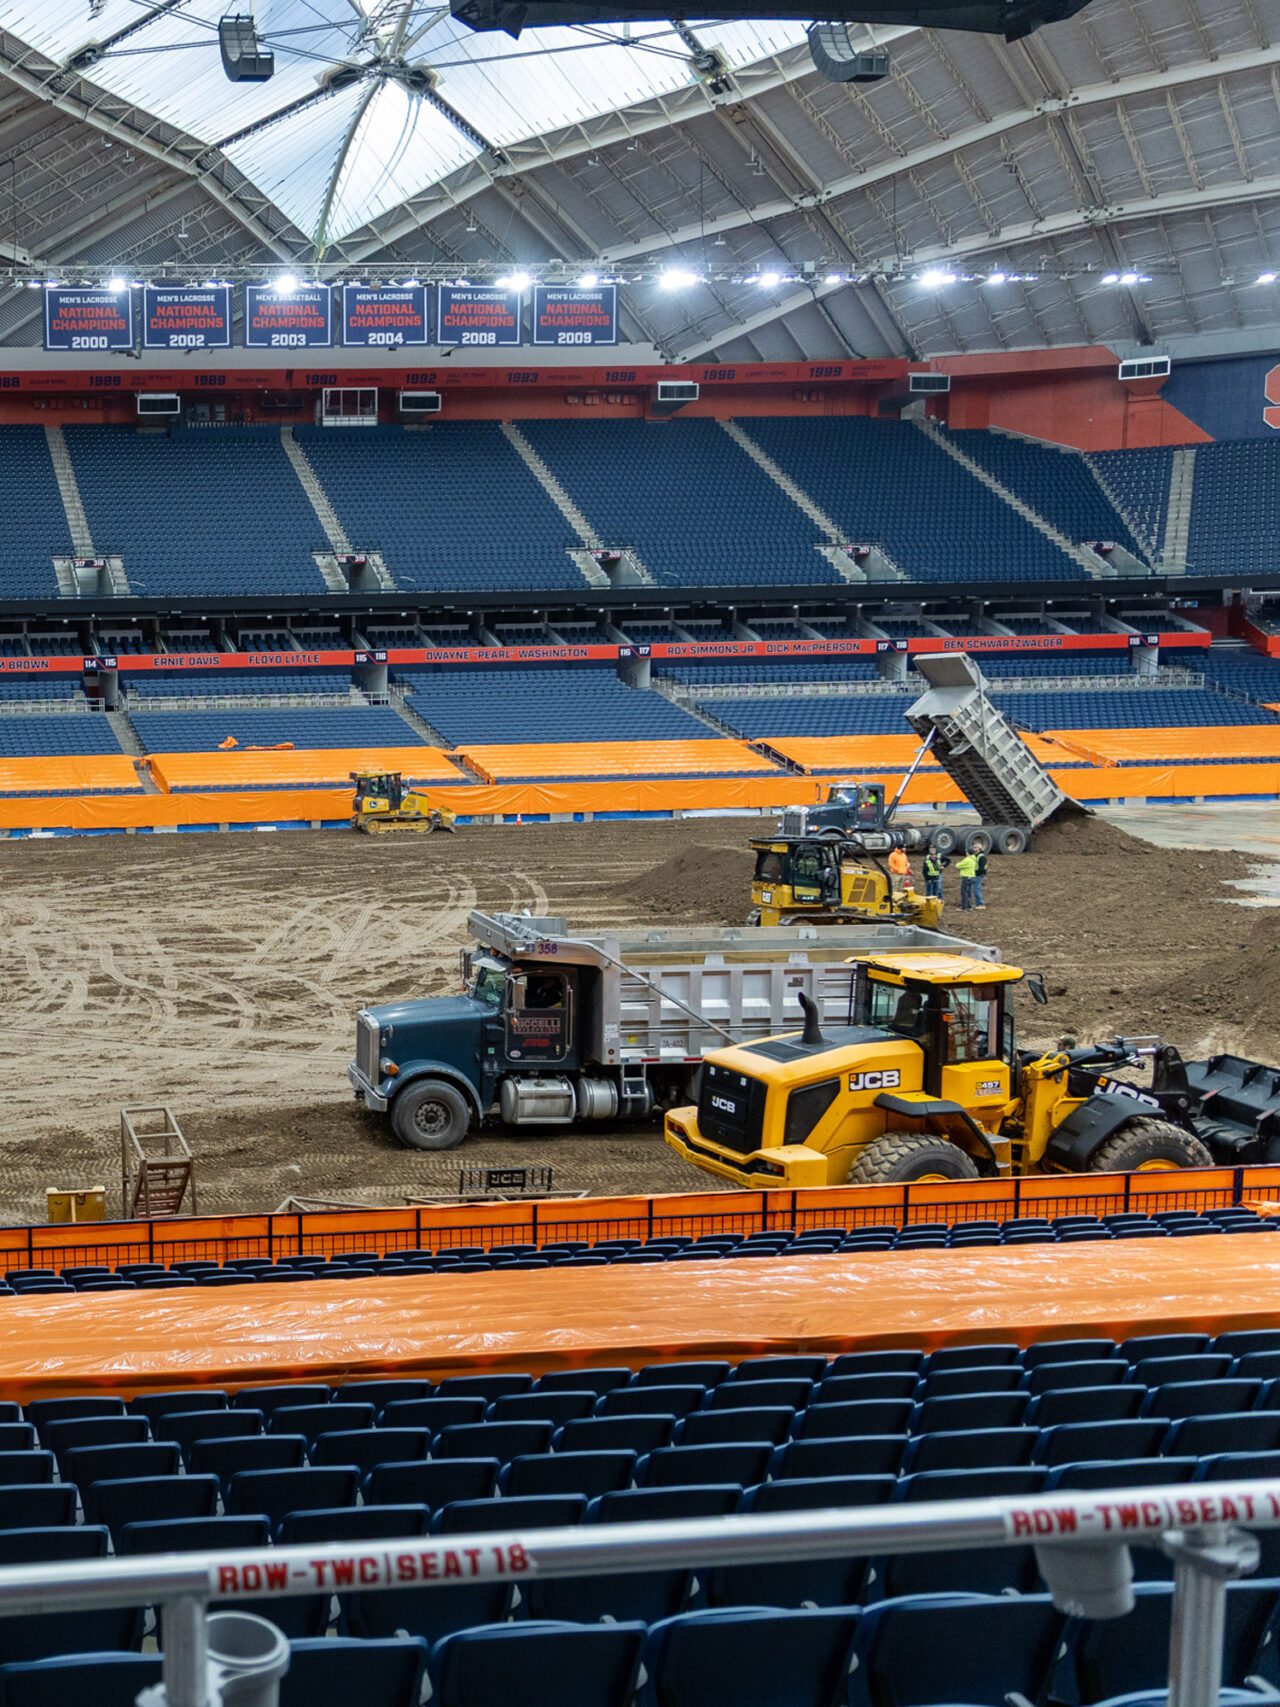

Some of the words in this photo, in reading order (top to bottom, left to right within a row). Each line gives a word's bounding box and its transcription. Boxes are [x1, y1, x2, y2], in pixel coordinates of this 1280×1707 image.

[180, 294, 216, 302] LACROSSE
[59, 307, 120, 318] NATIONAL
[156, 306, 217, 316] NATIONAL
[259, 305, 319, 316] NATIONAL
[356, 304, 415, 314] NATIONAL
[451, 304, 508, 314] NATIONAL
[546, 304, 604, 314] NATIONAL
[53, 319, 126, 330] CHAMPIONS
[150, 318, 223, 329] CHAMPIONS
[253, 317, 325, 328] CHAMPIONS
[350, 316, 421, 327] CHAMPIONS
[444, 316, 514, 326] CHAMPIONS
[540, 316, 610, 326] CHAMPIONS
[72, 336, 108, 348] 2000
[170, 335, 205, 346] 2002
[272, 334, 306, 346] 2003
[368, 333, 404, 344] 2004
[462, 332, 496, 344] 2008
[558, 332, 591, 344] 2009
[809, 367, 842, 378] 1999
[89, 376, 121, 386] 1989
[194, 375, 226, 386] 1989
[944, 640, 964, 649] BEN
[967, 638, 1063, 649] SCHWARTZWALDER
[1147, 635, 1158, 644] 119
[620, 648, 631, 656] 116
[639, 646, 650, 655] 117
[668, 646, 687, 655] ROY
[690, 645, 738, 655] SIMMONS
[766, 644, 790, 653] DICK
[878, 642, 888, 650] 117
[249, 655, 282, 665] FLOYD
[285, 654, 320, 664] LITTLE
[356, 653, 367, 662] 115
[375, 652, 387, 660] 116
[426, 651, 470, 660] DWAYNE
[519, 648, 588, 658] WASHINGTON
[8, 660, 49, 670] BROWN
[85, 660, 96, 668] 114
[105, 658, 117, 667] 115
[154, 657, 185, 666] ERNIE
[189, 656, 220, 666] DAVIS
[538, 943, 558, 954] 358
[849, 1070, 900, 1091] JCB
[712, 1096, 736, 1113] JCB
[496, 1543, 529, 1573] 18
